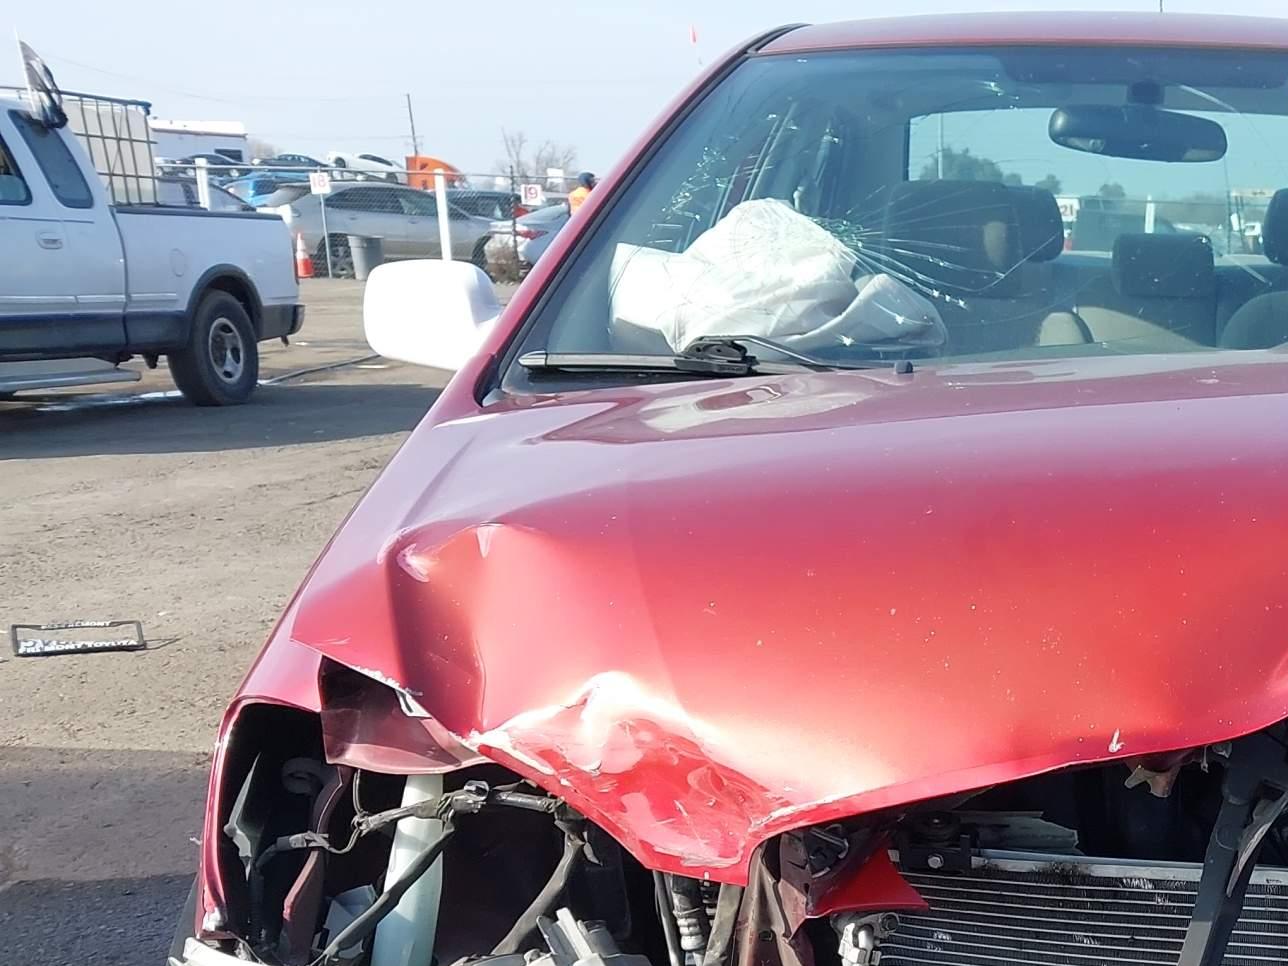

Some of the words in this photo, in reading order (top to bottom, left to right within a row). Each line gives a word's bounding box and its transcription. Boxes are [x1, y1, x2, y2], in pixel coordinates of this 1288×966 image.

[312, 174, 326, 188] 18
[524, 186, 538, 200] 19
[1060, 204, 1073, 216] 21
